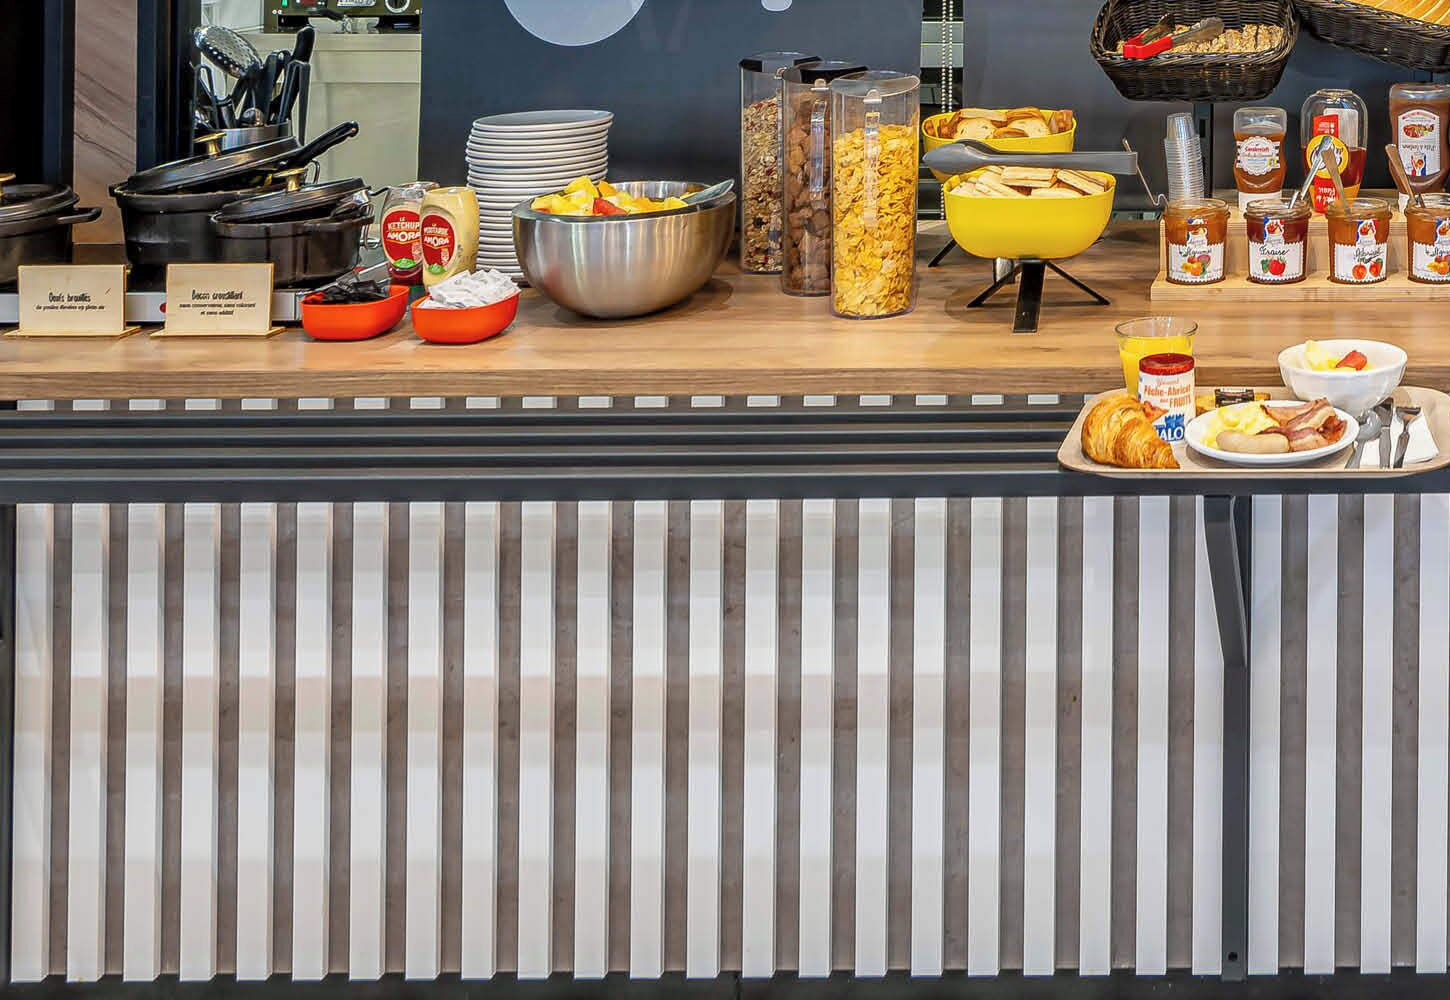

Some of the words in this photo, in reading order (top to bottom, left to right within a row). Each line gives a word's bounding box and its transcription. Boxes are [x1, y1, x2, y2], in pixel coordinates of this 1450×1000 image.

[388, 221, 420, 230] KETCHUP
[387, 231, 421, 242] AMORA
[424, 236, 449, 247] AMORA
[1259, 245, 1289, 256] Fraise
